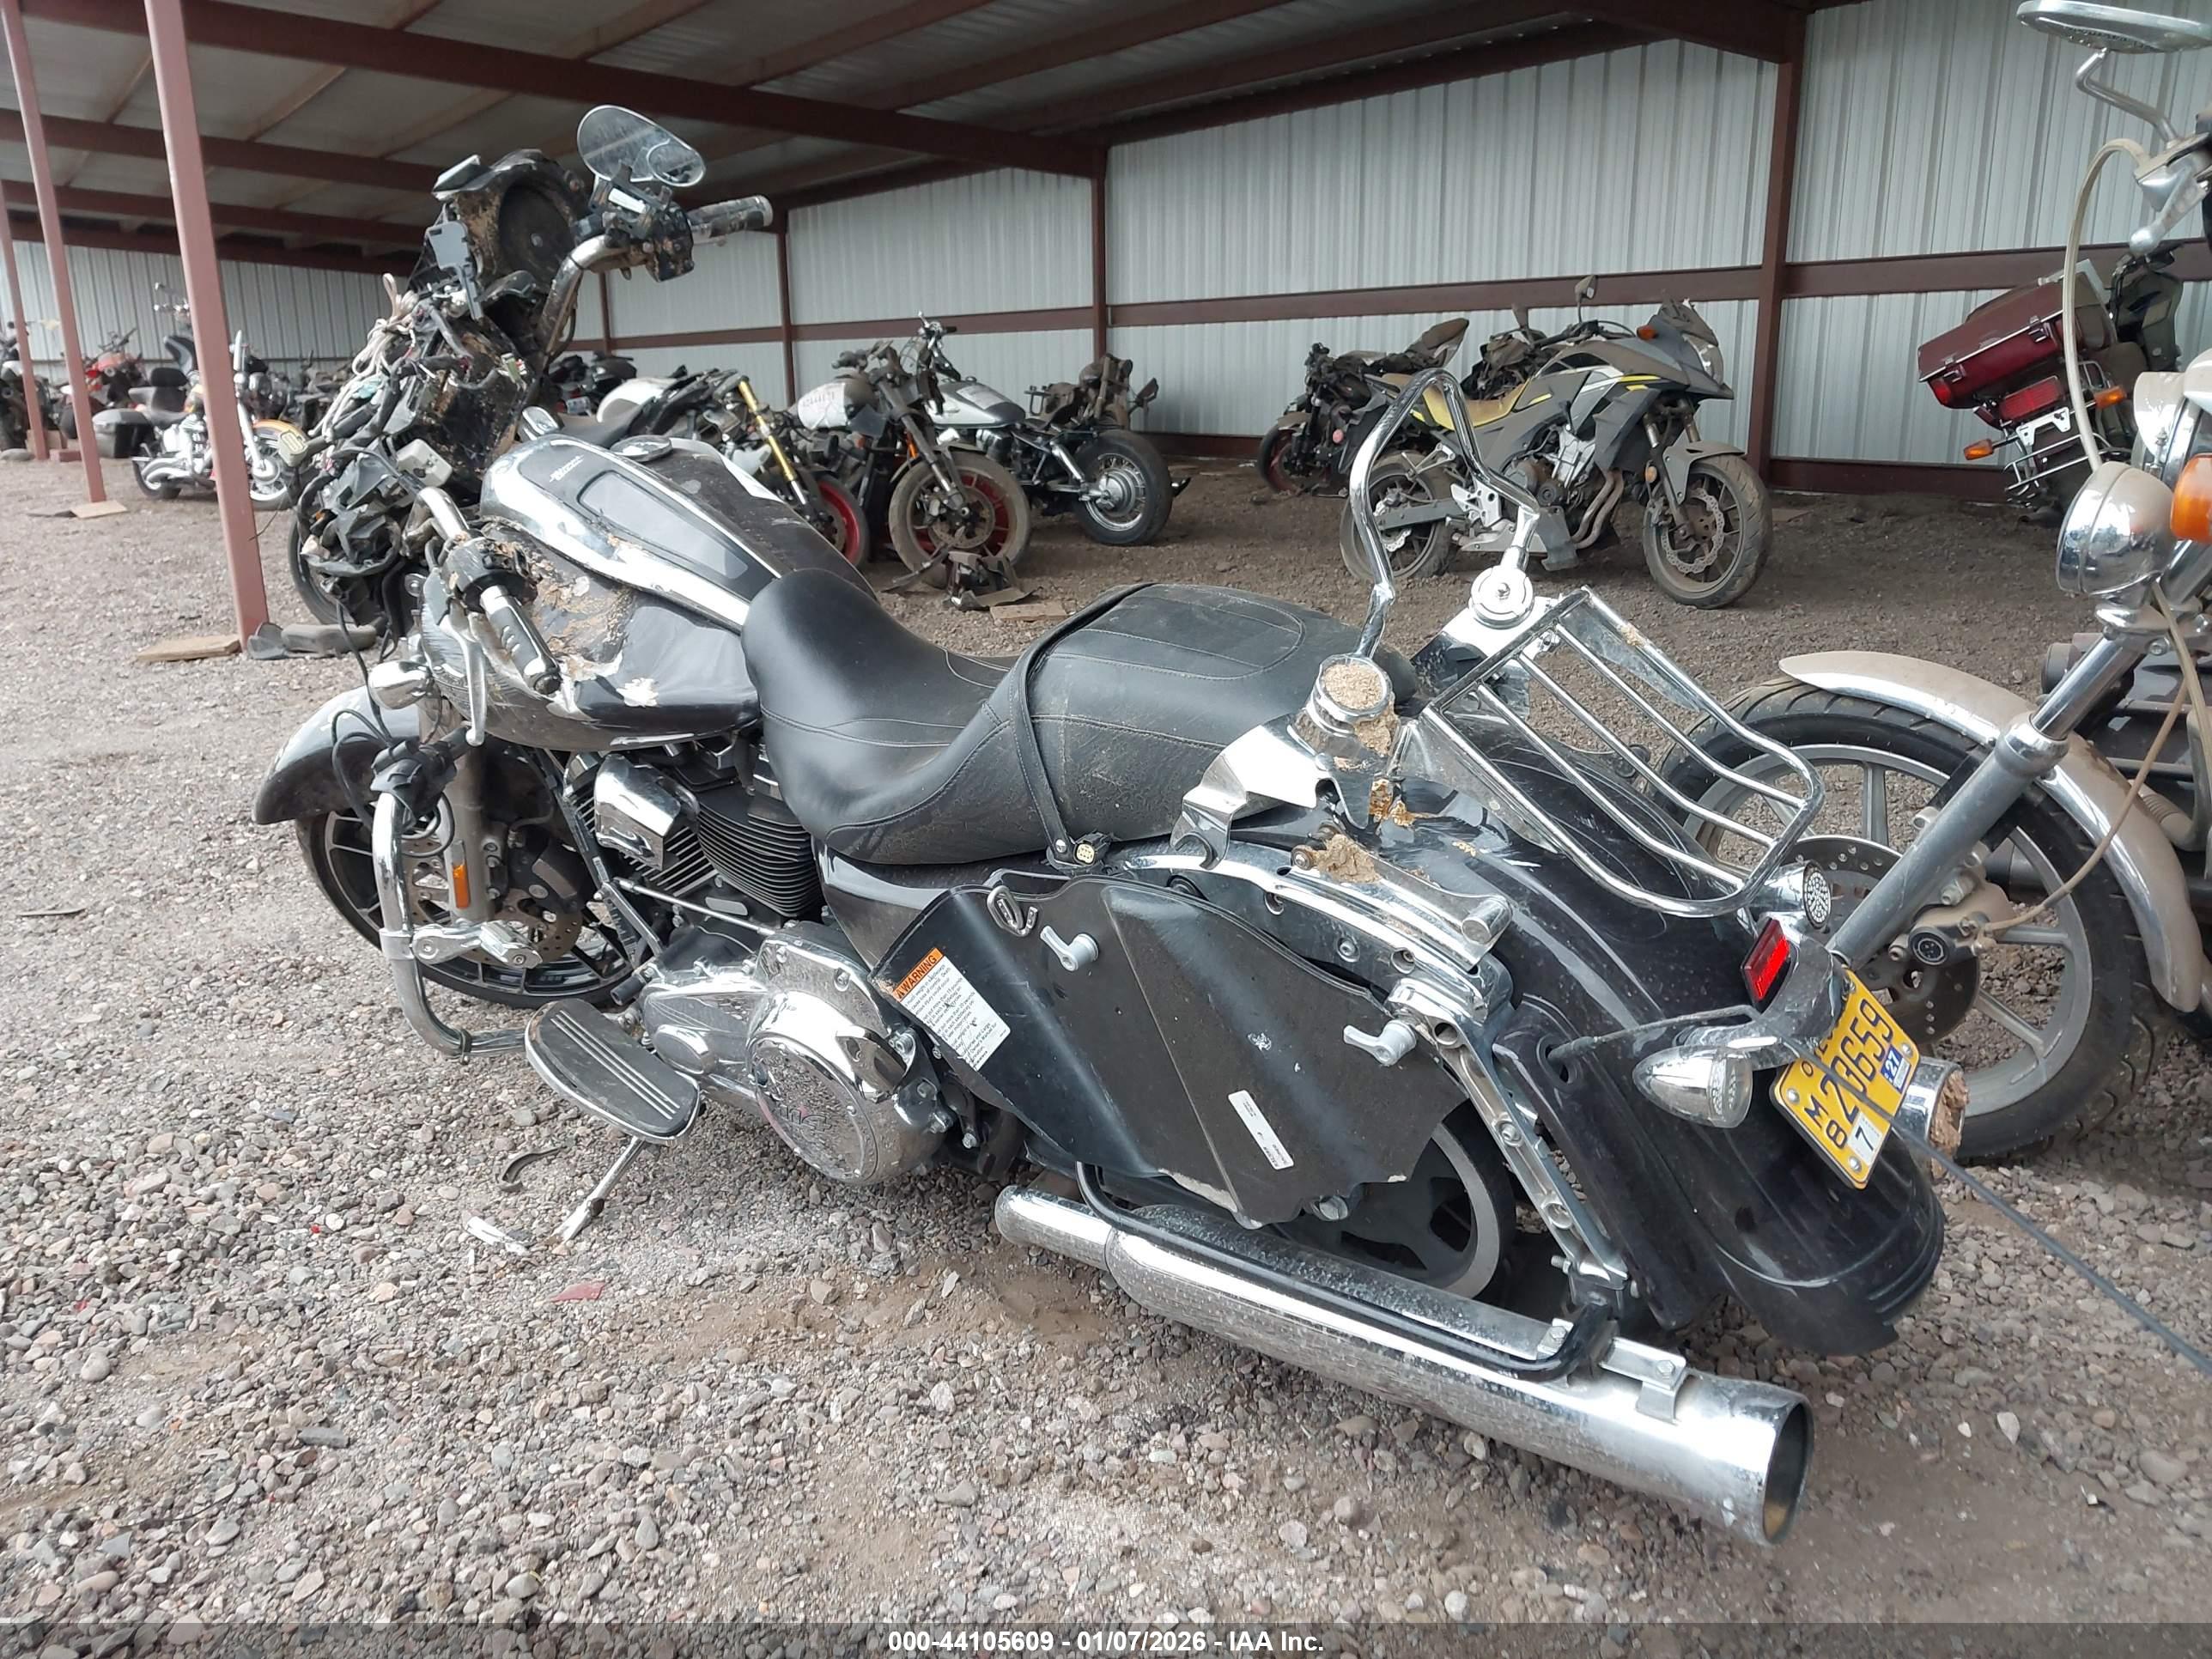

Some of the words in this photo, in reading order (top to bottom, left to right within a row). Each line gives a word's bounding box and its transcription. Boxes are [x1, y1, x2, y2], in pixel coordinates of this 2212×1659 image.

[901, 955, 937, 993] WARNING
[1820, 999, 1893, 1124] 23659
[1855, 1126, 1874, 1152] 7
